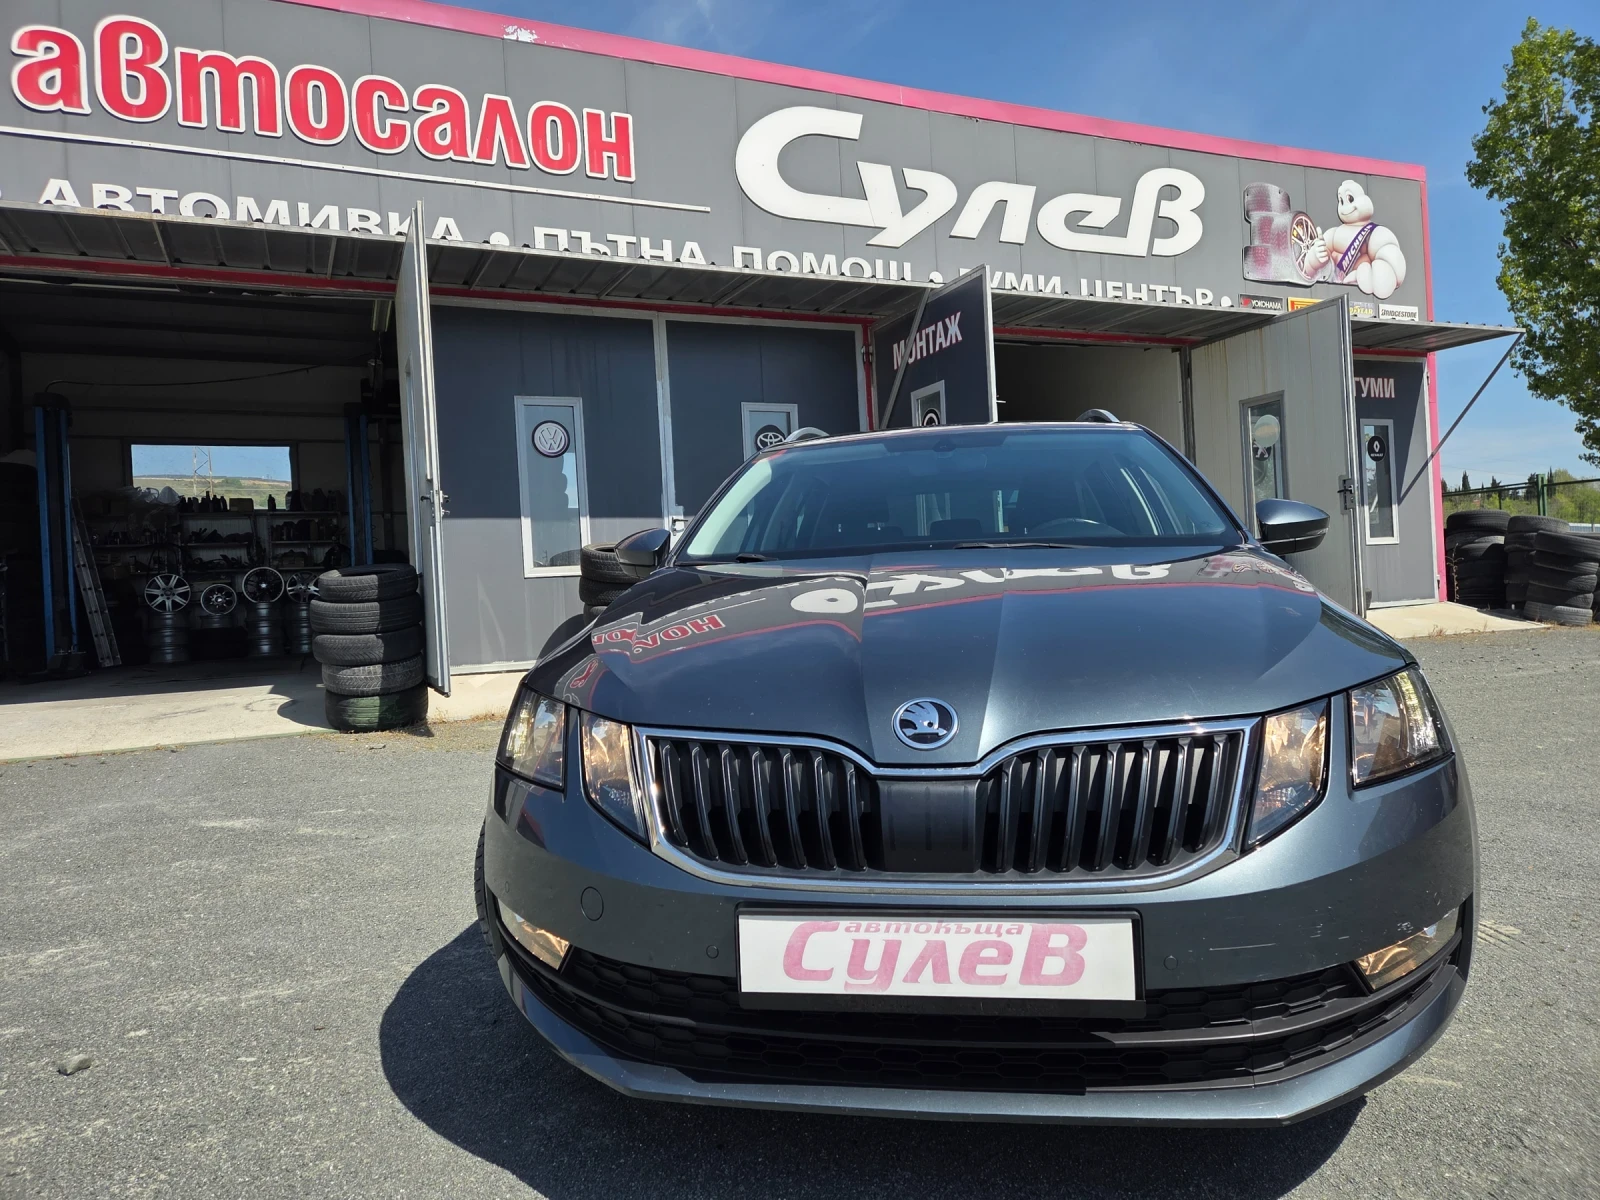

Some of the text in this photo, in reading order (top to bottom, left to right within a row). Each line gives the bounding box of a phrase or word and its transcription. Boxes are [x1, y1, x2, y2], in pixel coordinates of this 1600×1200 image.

[11, 14, 636, 183] автосалон
[533, 226, 706, 266] ПЪТНА
[959, 268, 1062, 293] УМИ
[1341, 224, 1373, 271] MICHELIN
[1251, 299, 1283, 310] YOKOHAMA
[1380, 308, 1417, 319] BRIDGESTONE
[844, 920, 1023, 938] автокъща
